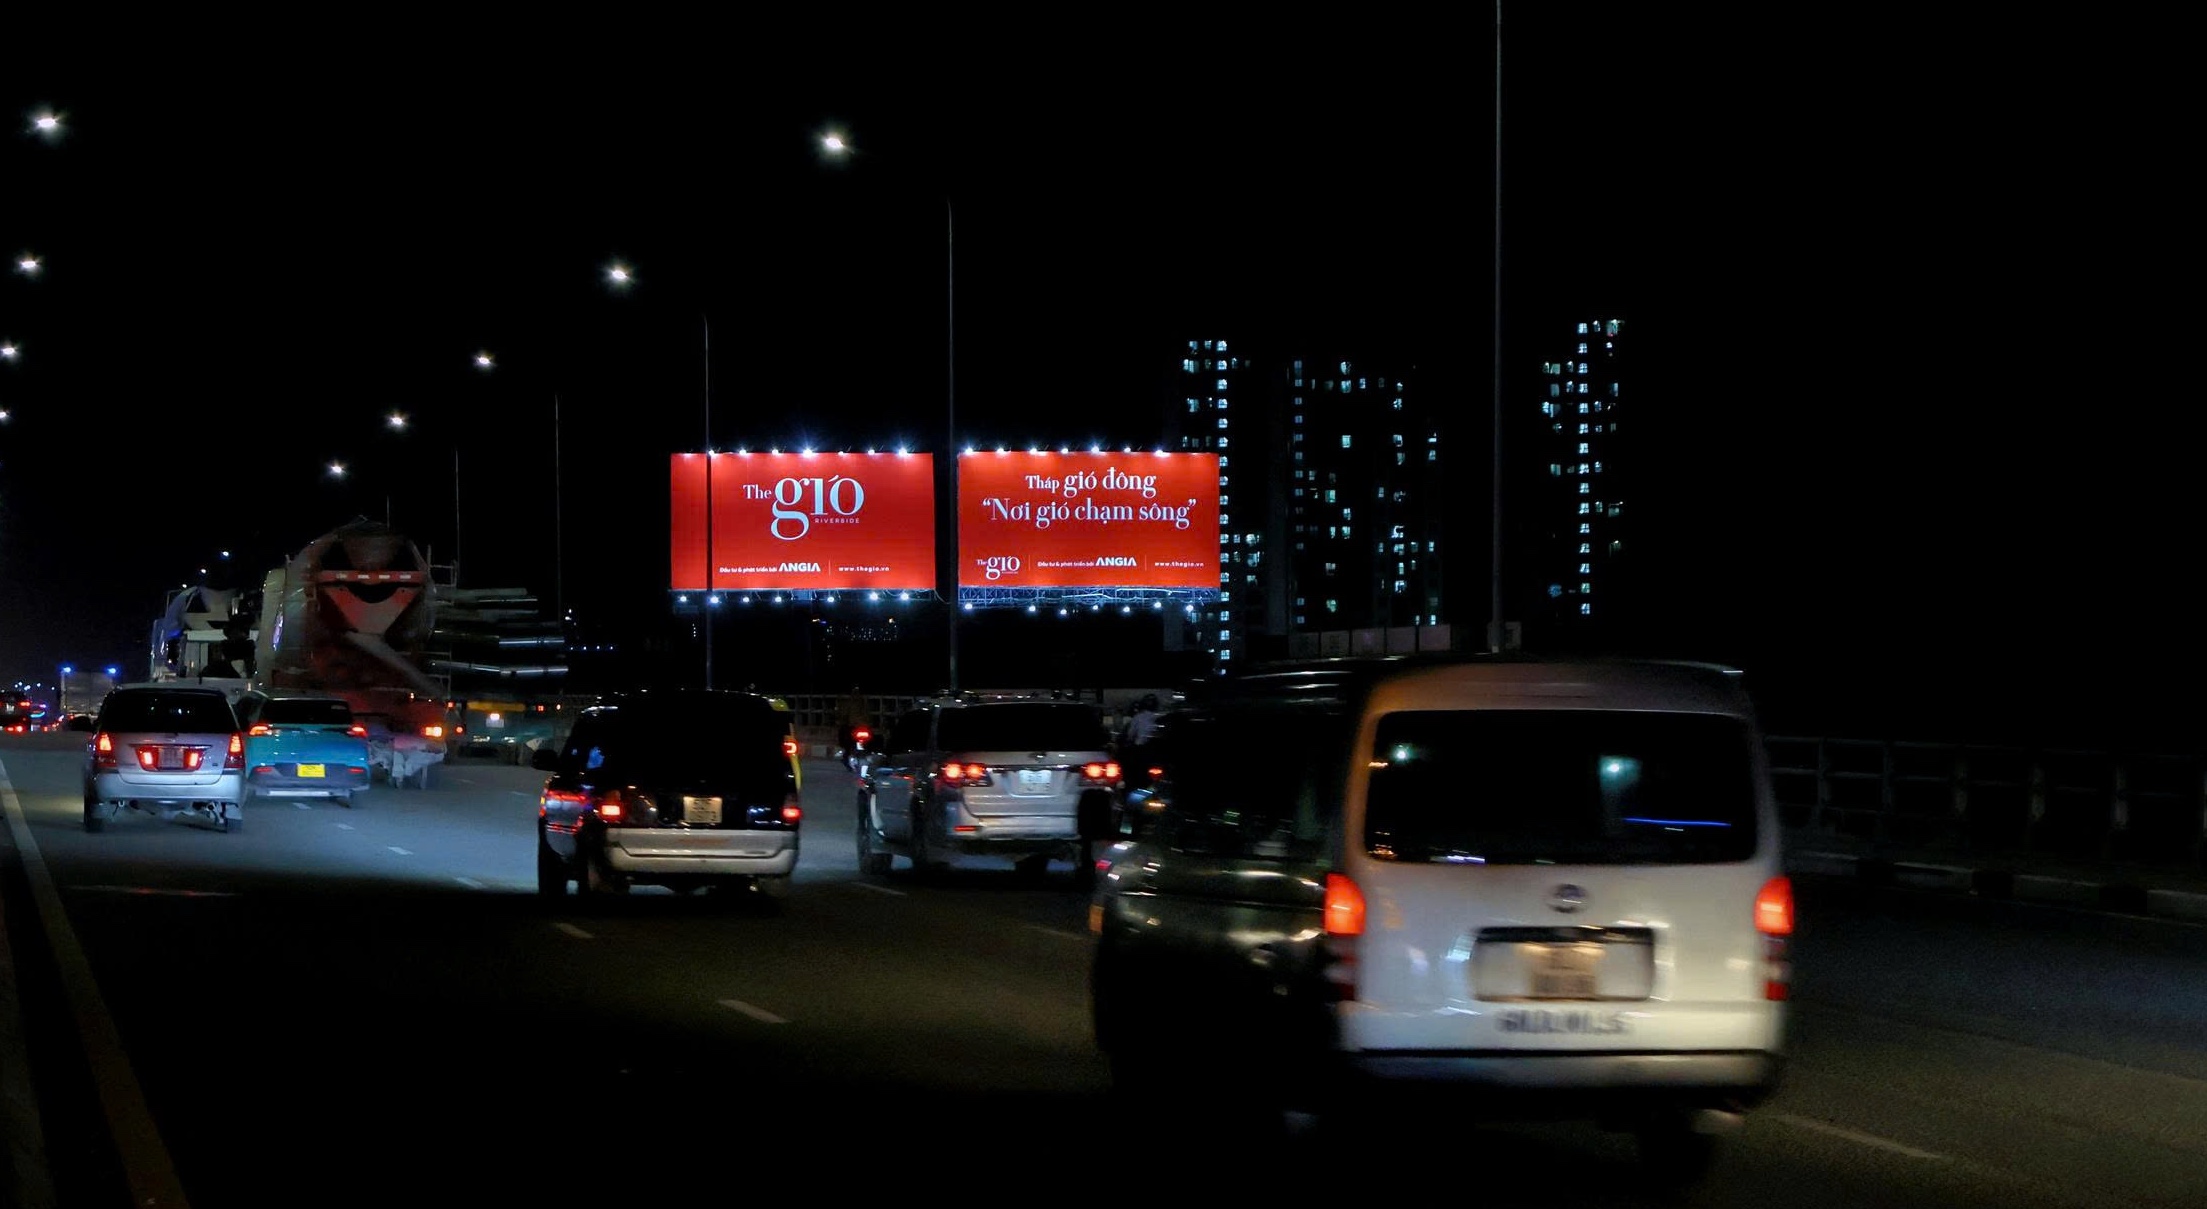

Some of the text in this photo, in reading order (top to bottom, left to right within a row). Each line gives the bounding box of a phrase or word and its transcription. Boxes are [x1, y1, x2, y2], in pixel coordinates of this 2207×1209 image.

[1025, 466, 1157, 498] Tháp gió đông
[743, 474, 865, 540] The gió
[982, 497, 1197, 530] “Nơi gió chạm sông”
[778, 562, 821, 572] ANGIA
[985, 555, 1021, 580] gió
[1095, 556, 1137, 567] ANGIA
